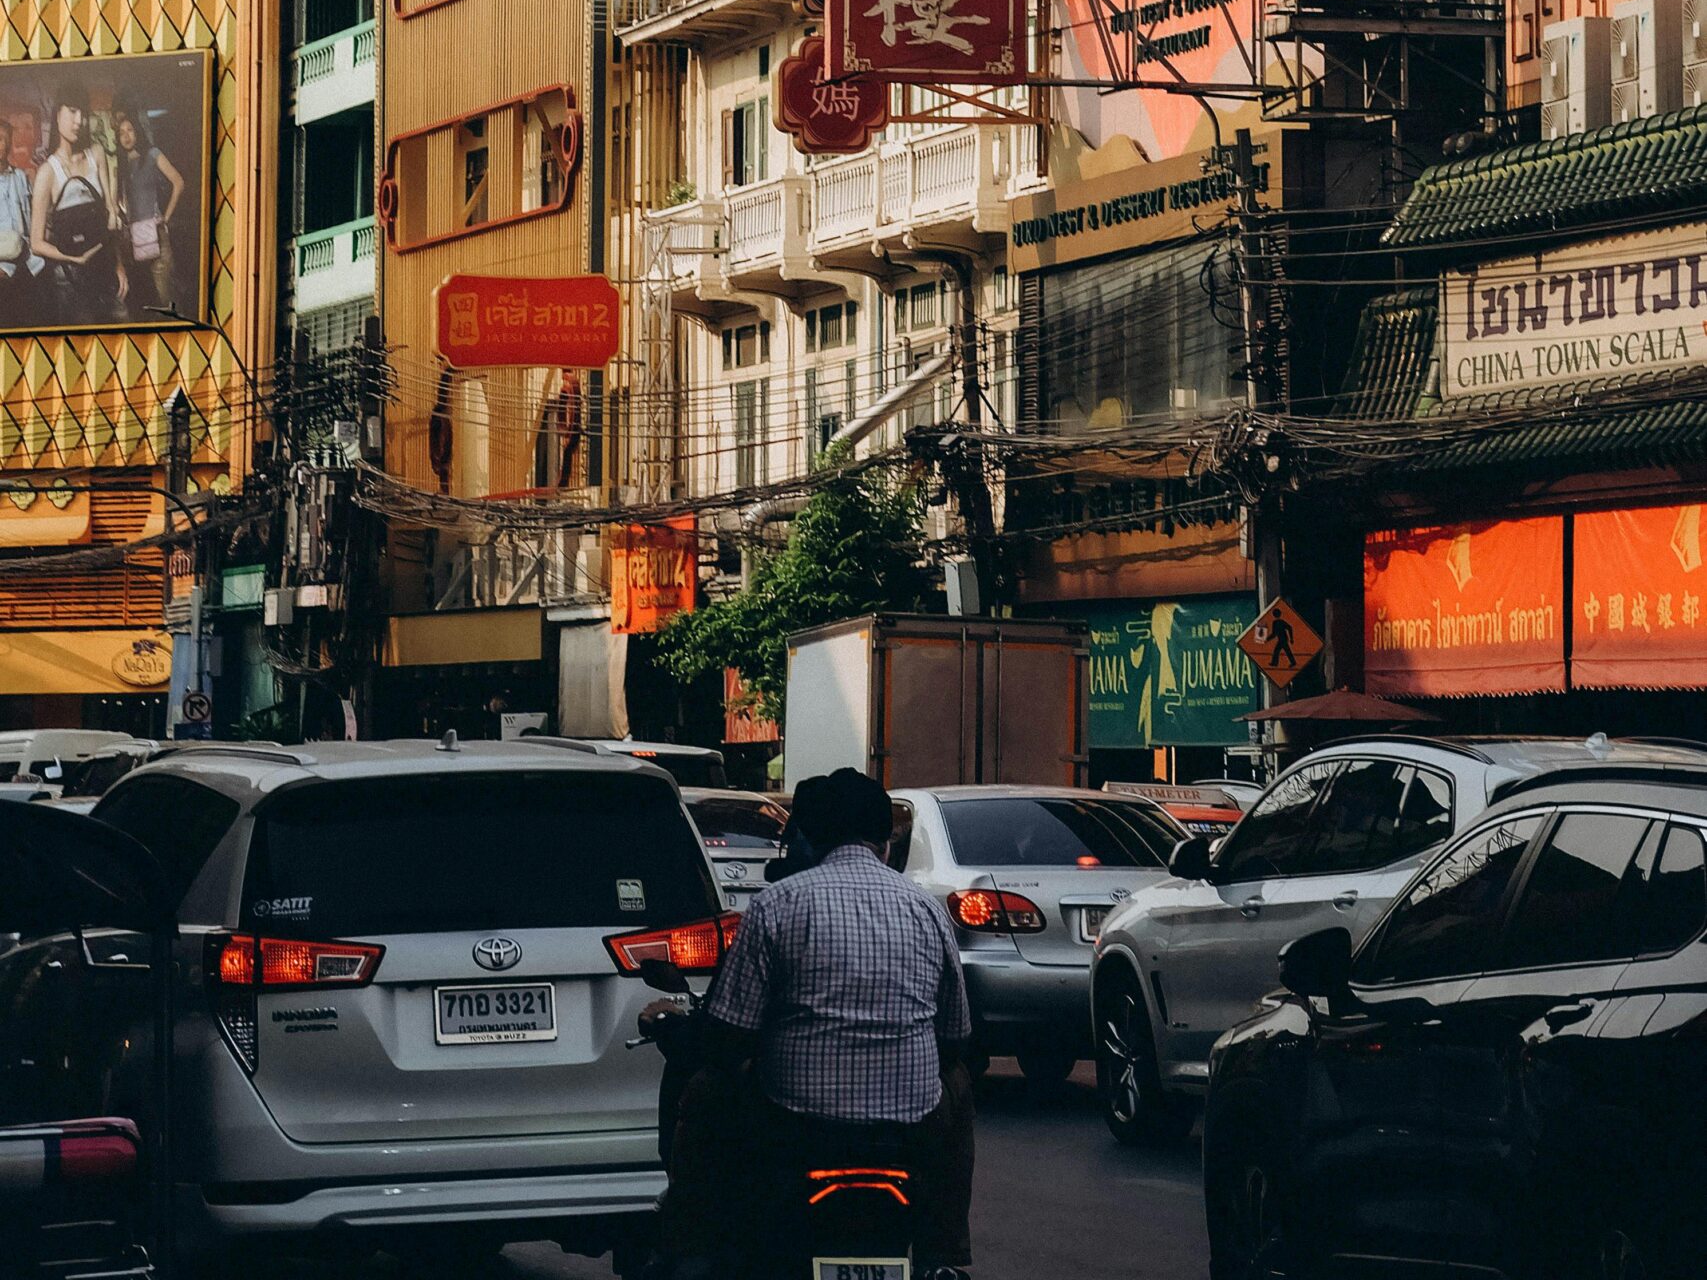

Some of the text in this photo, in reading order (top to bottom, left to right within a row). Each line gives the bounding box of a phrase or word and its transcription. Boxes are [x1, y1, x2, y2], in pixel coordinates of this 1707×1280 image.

[1013, 217, 1050, 247] BIRD
[1050, 207, 1085, 237] NEST
[1087, 204, 1099, 231] &
[1101, 186, 1167, 226] DESSERT
[1457, 350, 1525, 389] CHINA
[1532, 338, 1602, 377] TOWN
[1609, 326, 1690, 367] SCALA
[1181, 647, 1255, 698] JUMAMA
[272, 896, 314, 910] SATIT
[495, 990, 546, 1016] 3321
